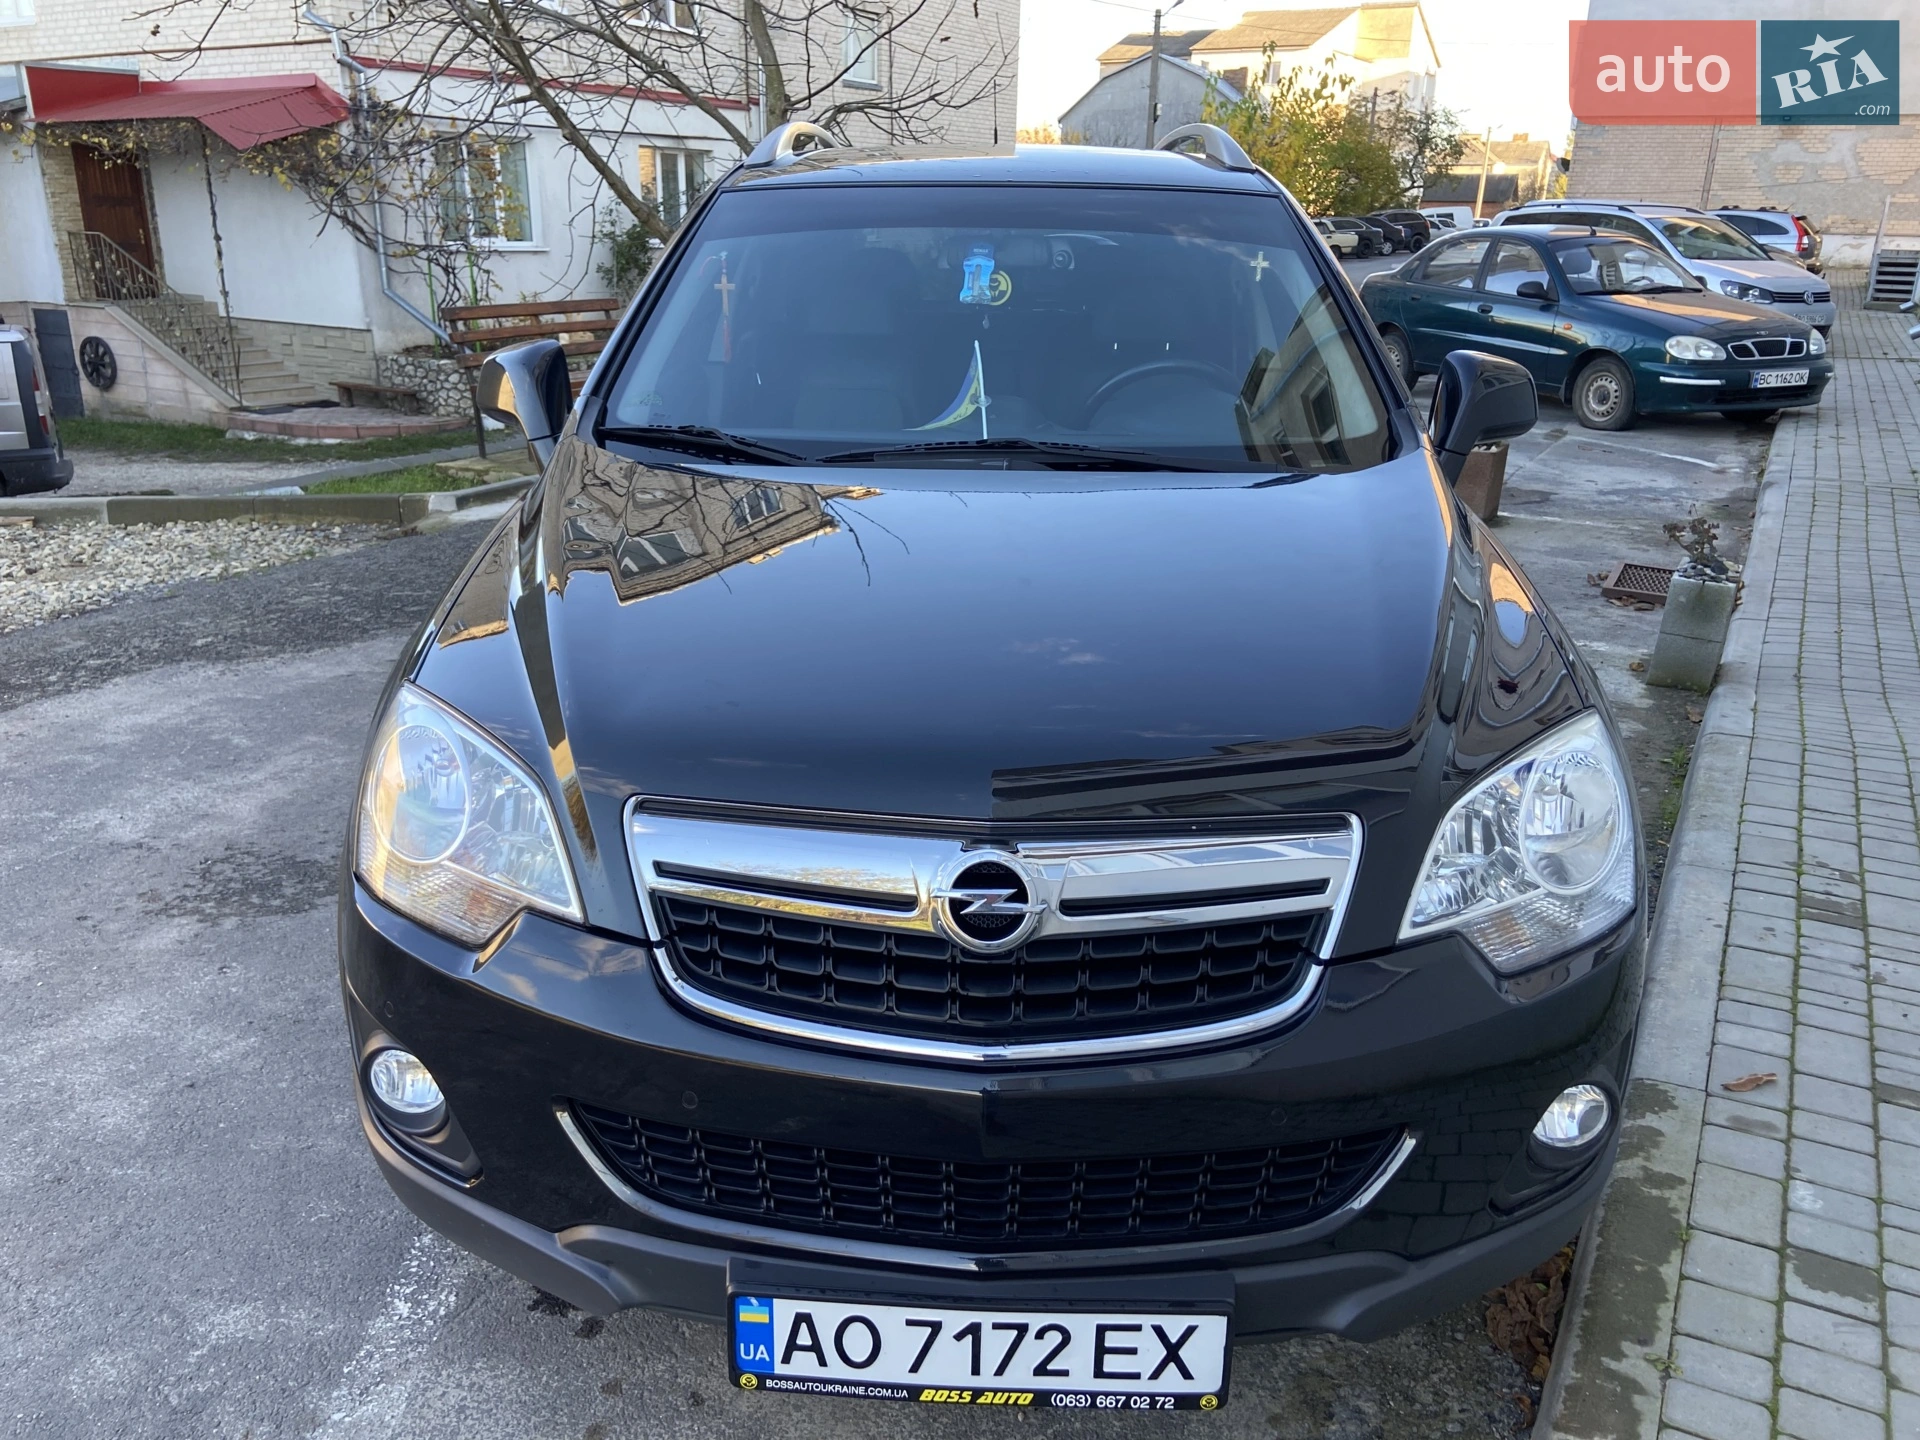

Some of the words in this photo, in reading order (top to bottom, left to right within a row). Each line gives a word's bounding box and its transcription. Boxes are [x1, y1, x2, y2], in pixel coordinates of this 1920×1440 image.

[1759, 374, 1772, 386] BC
[1774, 373, 1793, 384] 1162
[1794, 372, 1806, 383] OK
[740, 1342, 771, 1362] UA
[780, 1311, 883, 1370] AO
[905, 1318, 1072, 1377] 7172
[1093, 1323, 1199, 1380] EX
[765, 1379, 909, 1398] BOSSAUTOUKRAINE.COM.UA
[919, 1388, 973, 1403] BOSS
[975, 1391, 1034, 1405] AUTO
[1050, 1394, 1092, 1408] (063)
[1096, 1395, 1125, 1408] 667
[1130, 1395, 1151, 1409] 02
[1155, 1396, 1176, 1409] 72
